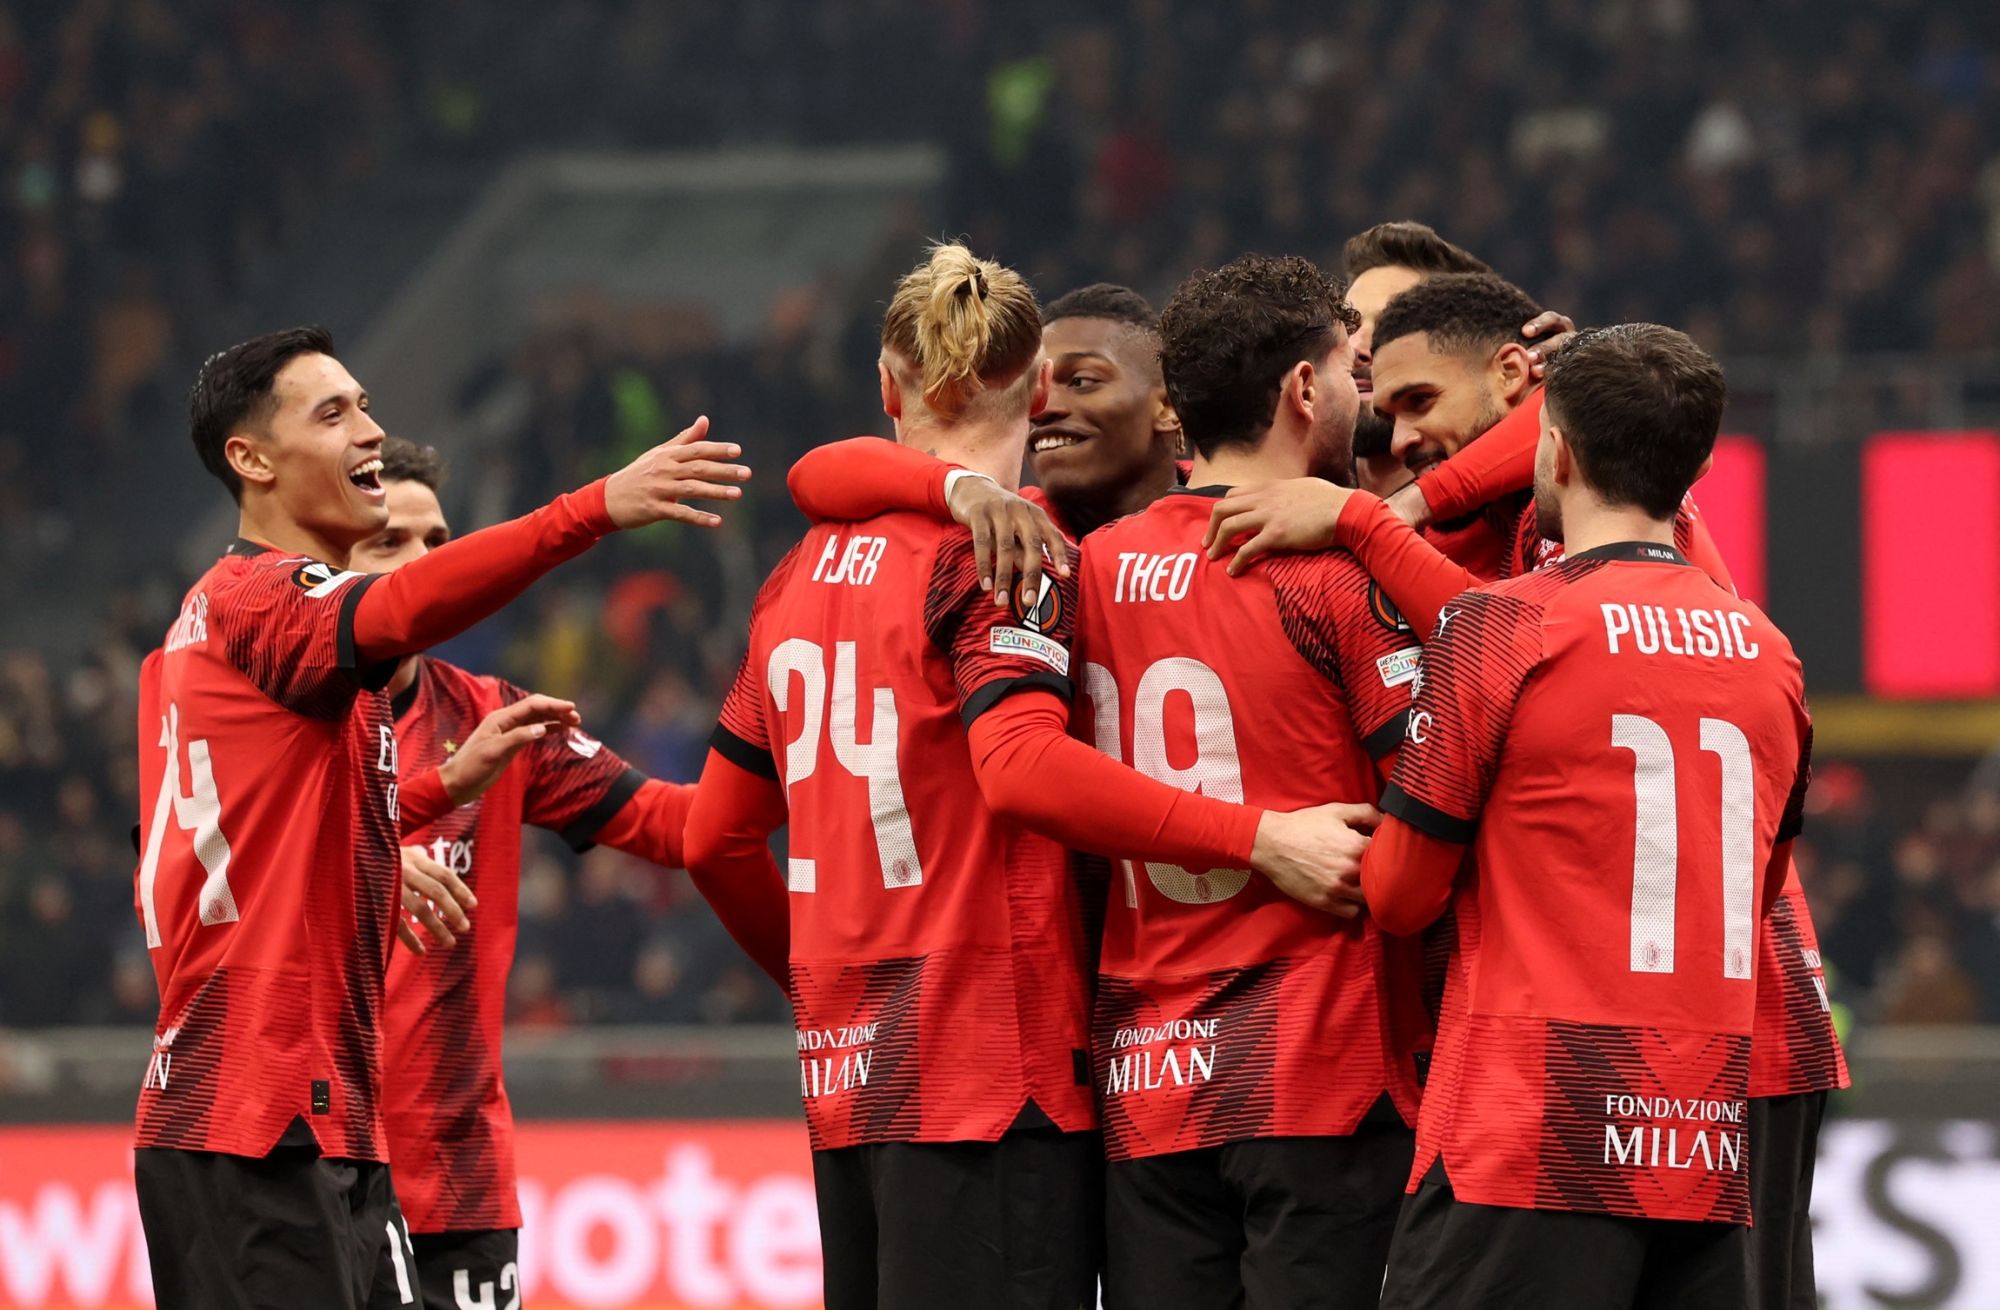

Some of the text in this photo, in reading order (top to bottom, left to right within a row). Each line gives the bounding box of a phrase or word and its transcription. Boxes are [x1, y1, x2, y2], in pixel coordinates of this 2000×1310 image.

[1648, 548, 1674, 560] MILAN
[1115, 552, 1198, 602] THEO
[993, 627, 1014, 636] UEFA
[993, 634, 1067, 668] FOUNDATION
[1600, 603, 1759, 659] PULISIC
[1380, 655, 1399, 667] UEFA
[768, 638, 922, 892] 24
[140, 703, 239, 949] 14
[1612, 714, 1754, 979] 11
[796, 1022, 879, 1050] NDAZIONE
[1112, 1018, 1220, 1048] FONDAZIONE
[1106, 1045, 1215, 1095] MILAN
[1606, 1094, 1743, 1122] FONDAZIONE
[1604, 1124, 1741, 1171] MILAN
